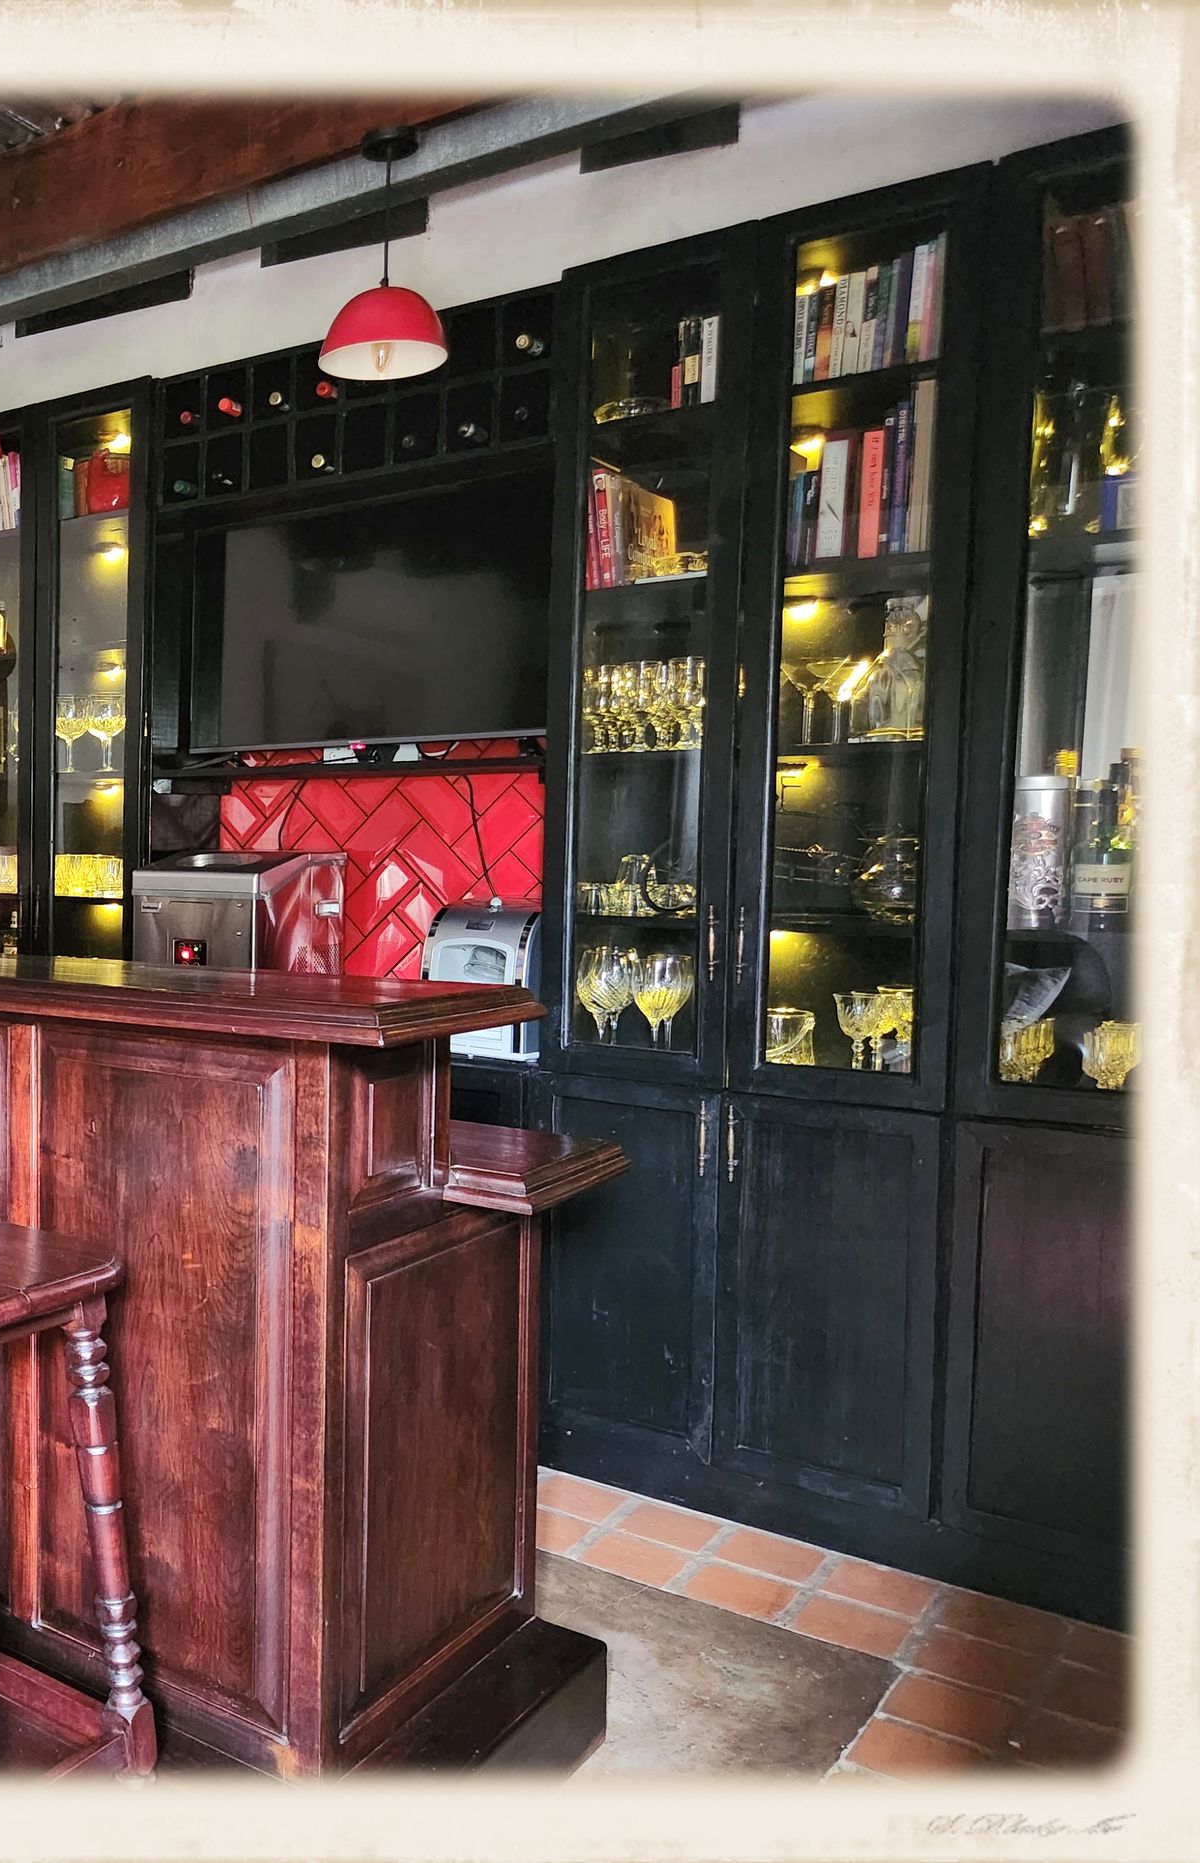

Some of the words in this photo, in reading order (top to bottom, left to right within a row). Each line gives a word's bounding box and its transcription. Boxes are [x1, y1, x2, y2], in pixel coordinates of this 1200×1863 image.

[836, 278, 847, 325] DIAMOND
[807, 332, 815, 358] SHACK
[897, 409, 907, 443] DIGITAL
[597, 508, 607, 529] Body
[601, 539, 611, 559] LIFE
[1078, 876, 1098, 884] CAPE
[1100, 876, 1125, 884] RUBY
